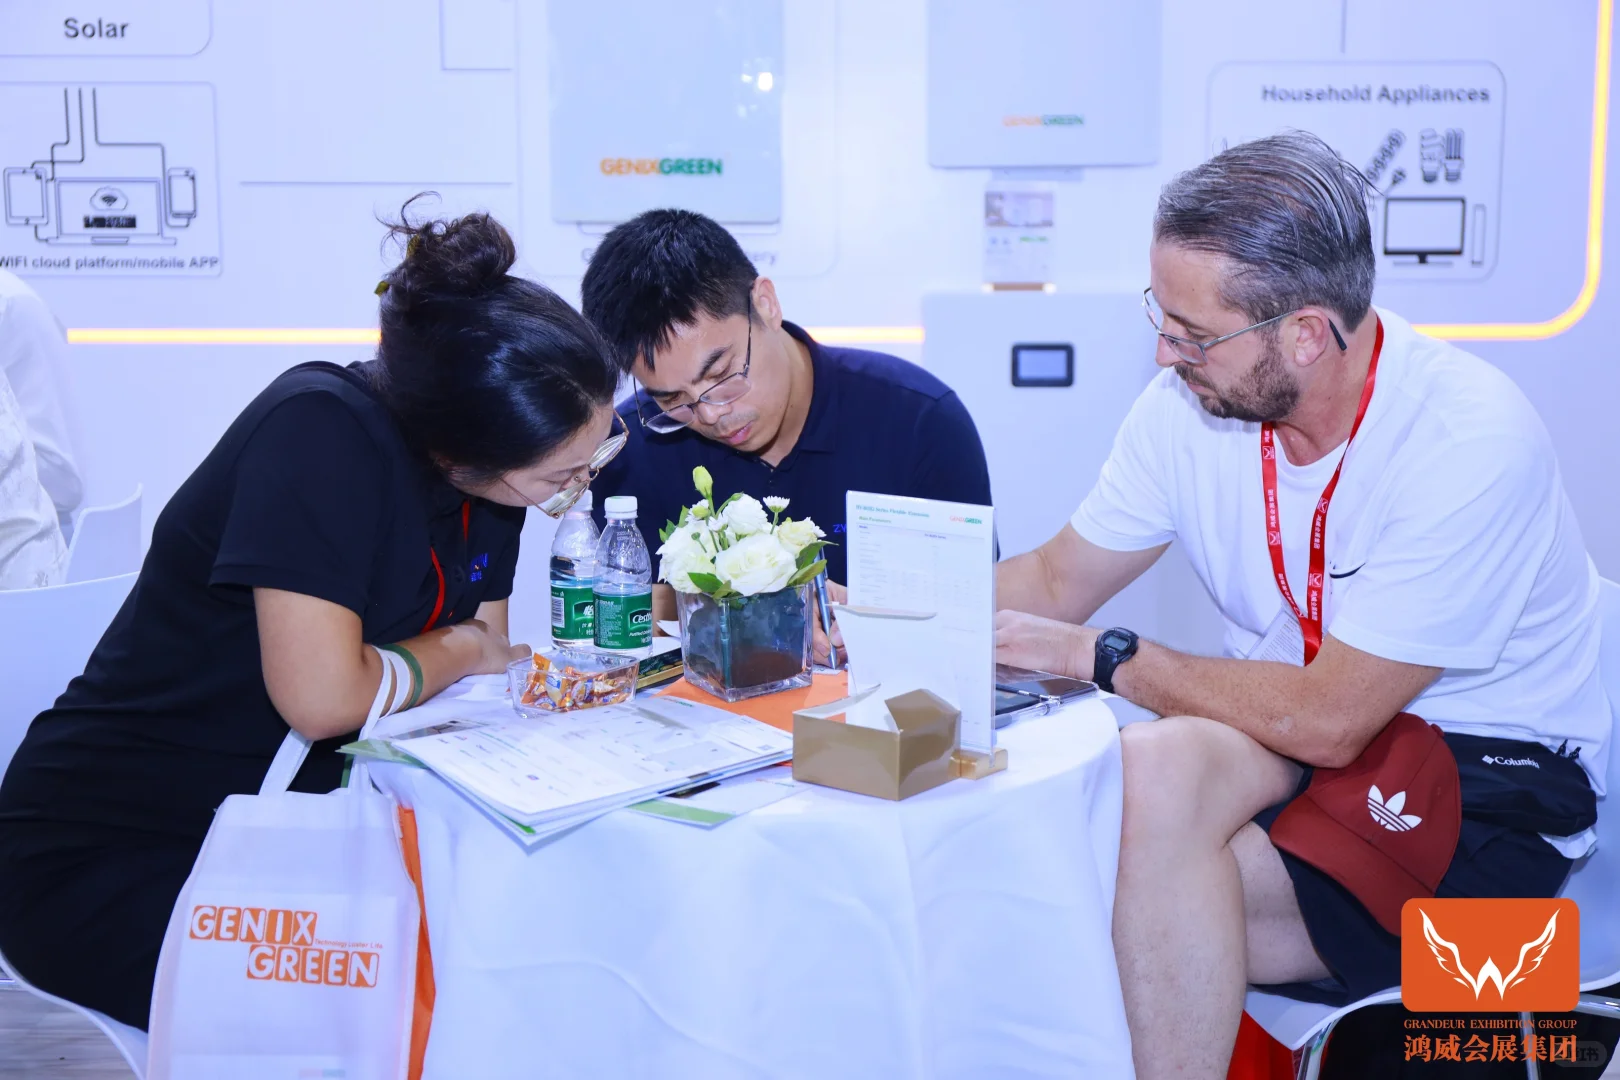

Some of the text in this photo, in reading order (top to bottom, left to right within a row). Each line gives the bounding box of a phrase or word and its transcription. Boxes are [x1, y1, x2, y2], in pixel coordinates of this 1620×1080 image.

[64, 17, 129, 39] Solar
[1261, 84, 1490, 105] Household Appliances
[600, 157, 723, 176] GENIXGREEN
[32, 255, 71, 269] cloud
[75, 255, 185, 271] platform/mobile
[189, 256, 219, 269] APP
[1494, 756, 1540, 769] Columbia
[189, 905, 317, 946] GENIX
[246, 943, 380, 988] GREEN
